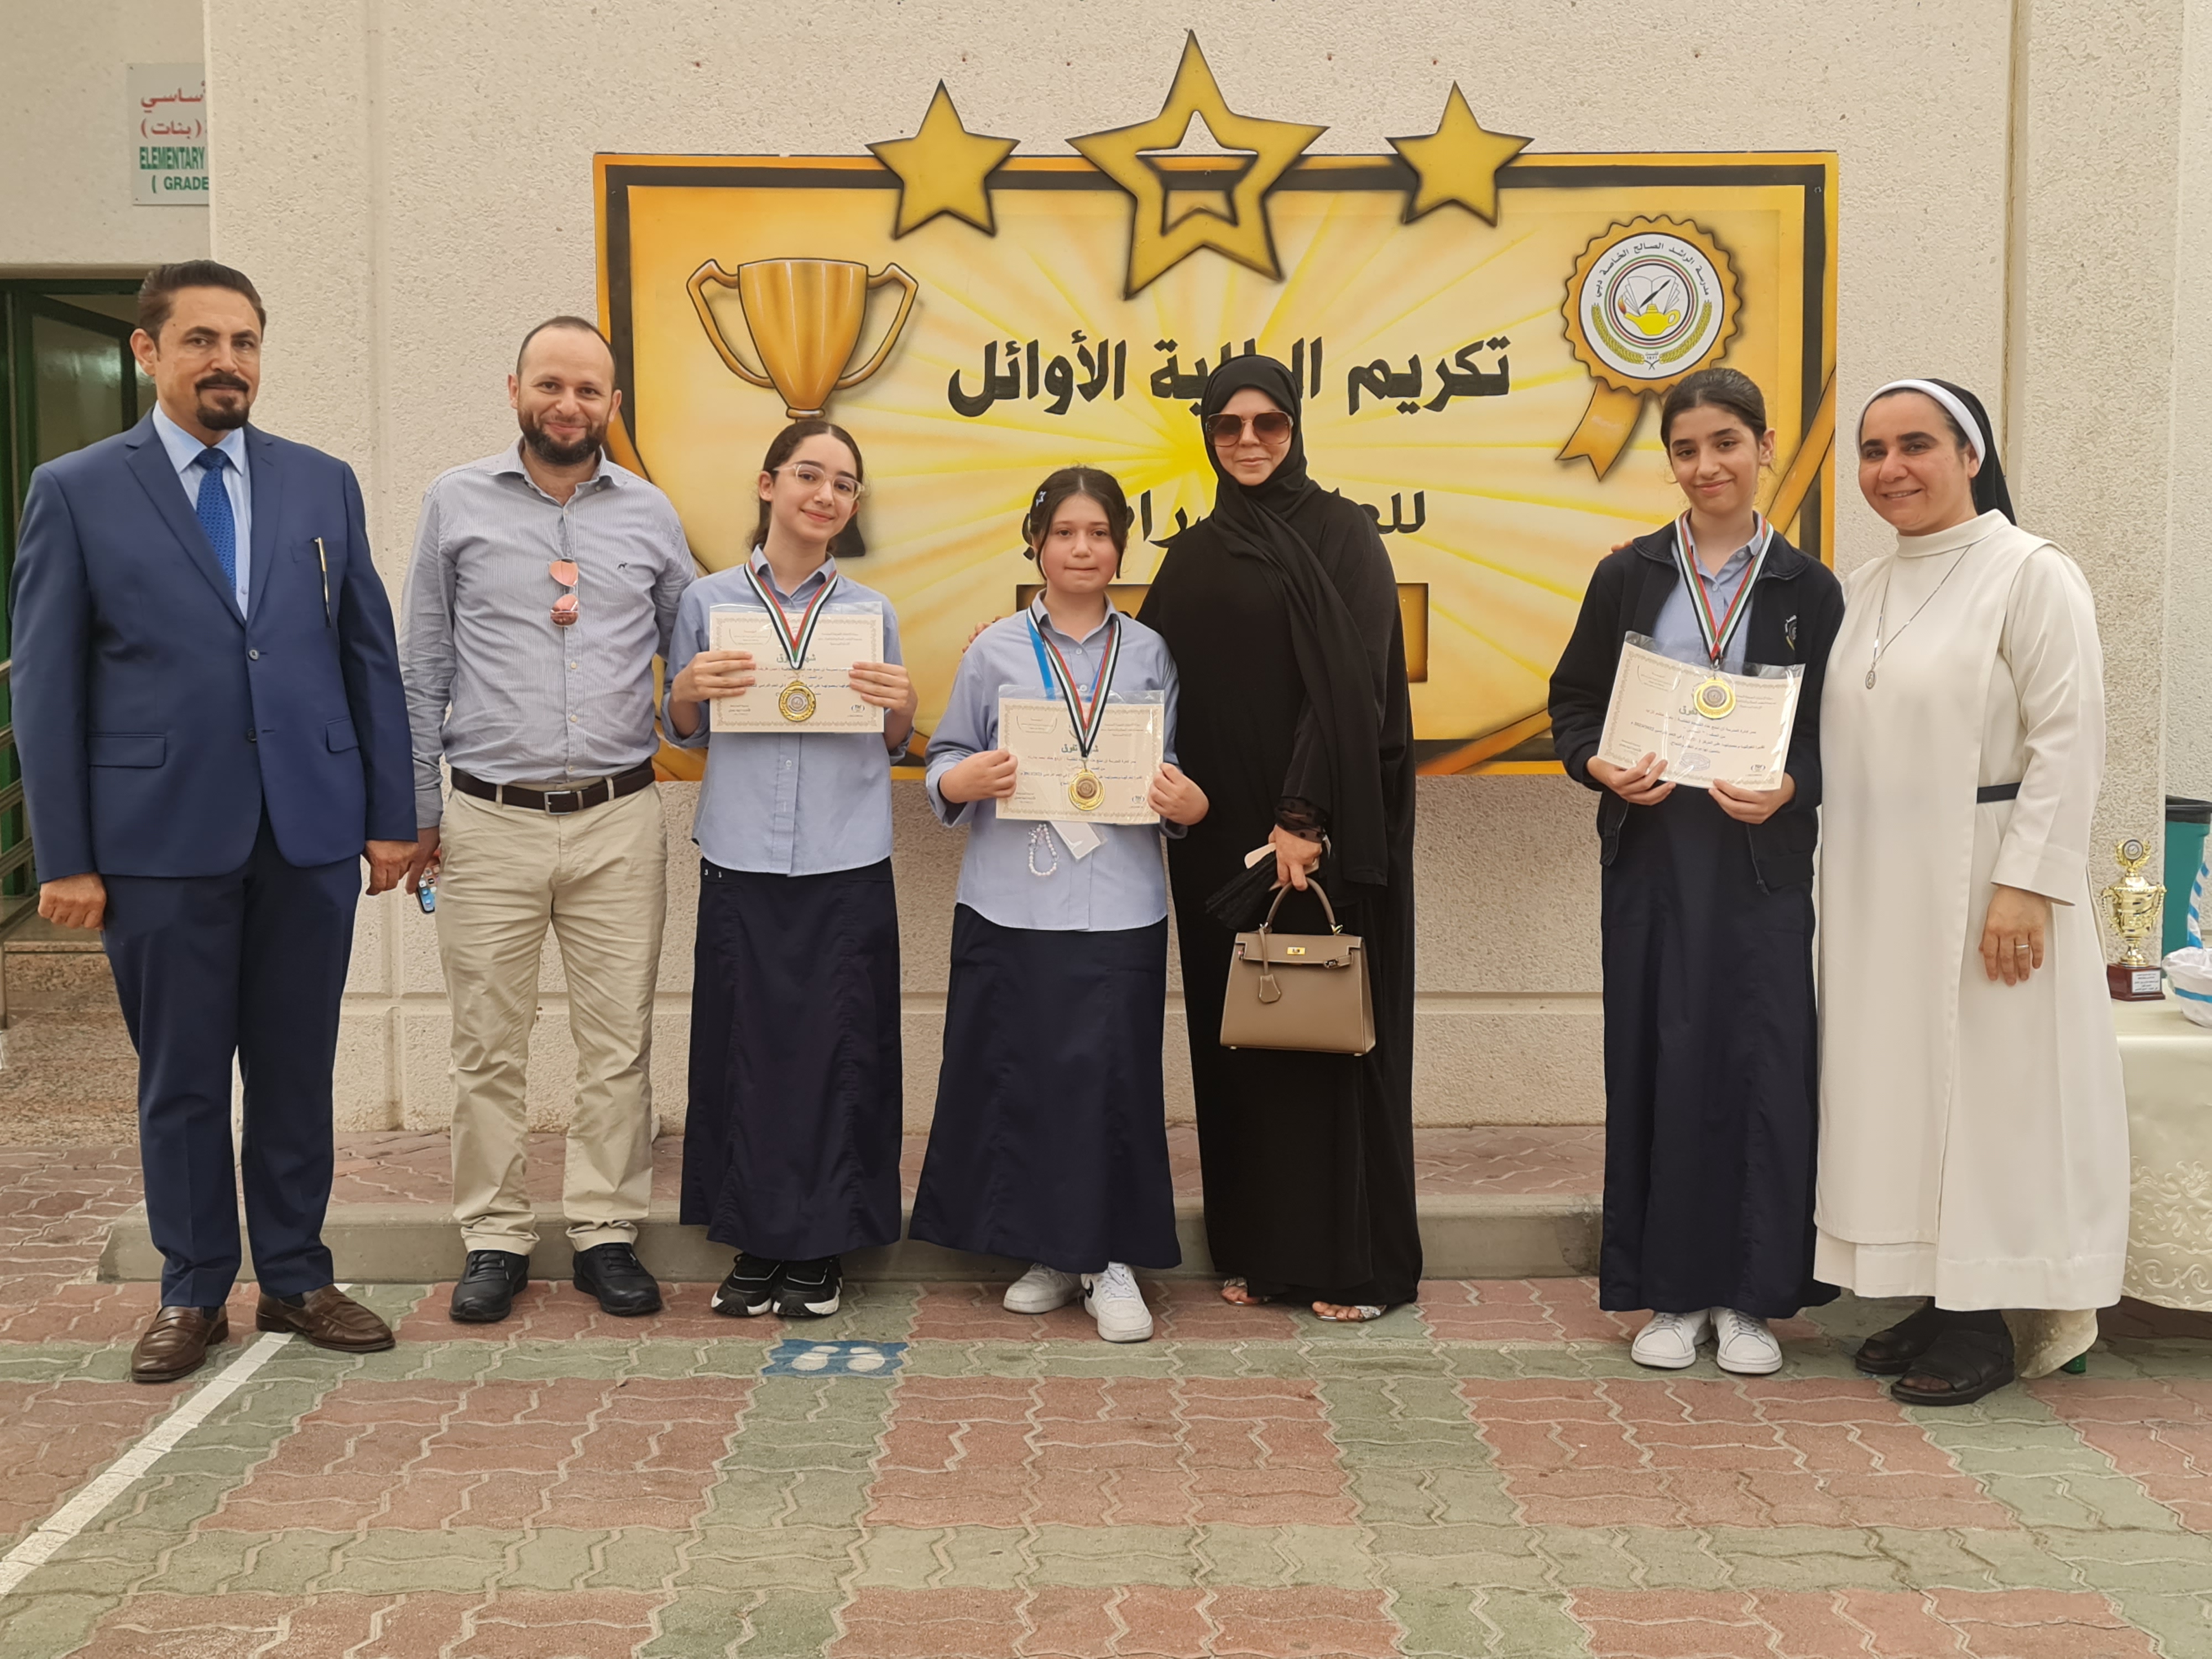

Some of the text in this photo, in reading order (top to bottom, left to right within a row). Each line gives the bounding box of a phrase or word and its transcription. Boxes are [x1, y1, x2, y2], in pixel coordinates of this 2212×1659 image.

[140, 147, 205, 169] ELEMENTARY
[1634, 242, 1664, 254] الصالح
[1669, 247, 1695, 265] الراشد
[1599, 248, 1629, 275] الخاصة
[1695, 265, 1709, 295] مدرسة
[948, 330, 1511, 418] تكريم البة الأوائل
